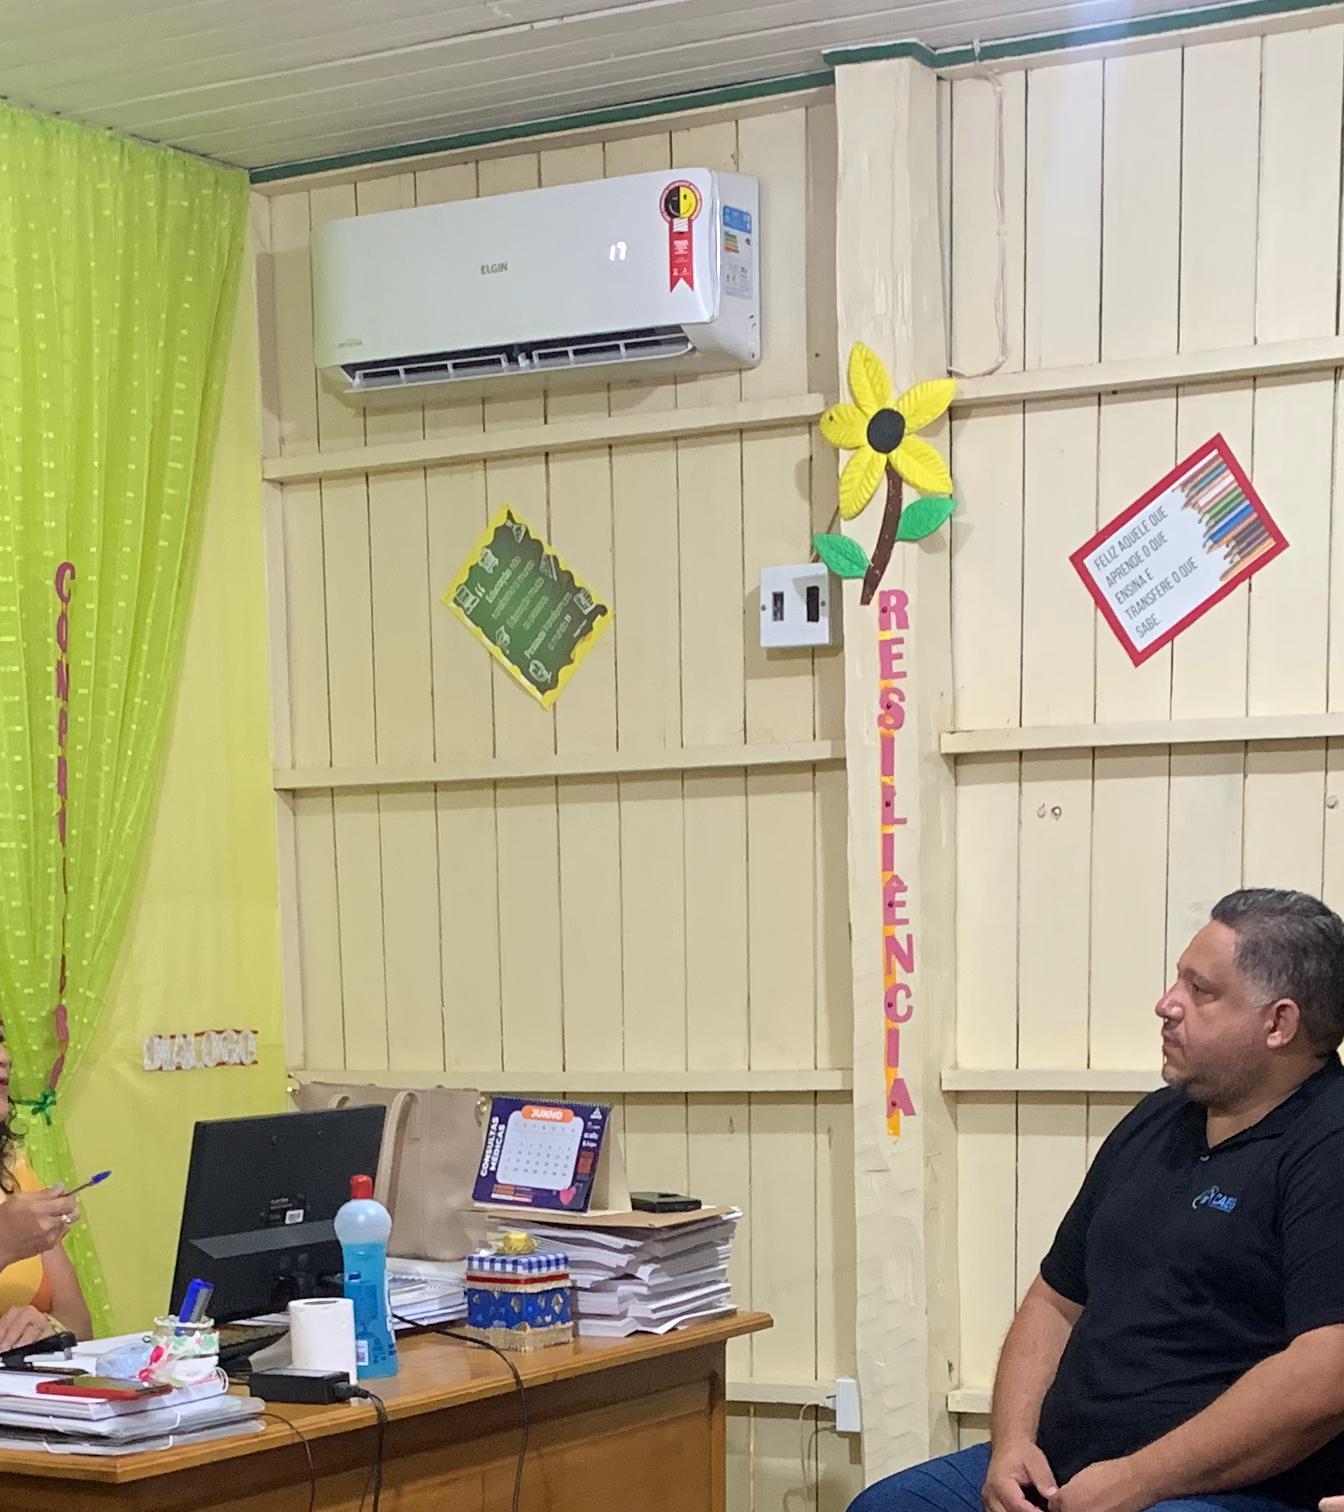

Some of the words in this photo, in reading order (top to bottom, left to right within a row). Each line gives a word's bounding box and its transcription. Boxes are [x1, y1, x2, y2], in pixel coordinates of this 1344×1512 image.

[480, 261, 508, 275] ELGIN
[1093, 547, 1120, 572] FELIZ
[1117, 519, 1152, 556] AQUELE
[1148, 505, 1168, 528] QUE
[1105, 547, 1144, 589] APRENDE
[1142, 545, 1150, 558] O
[1148, 531, 1168, 553] QUE
[1114, 573, 1147, 605] ENSINA
[1145, 567, 1153, 581] E
[1124, 574, 1175, 621] TRANSFERE
[1172, 571, 1181, 584] O
[1178, 556, 1199, 580] QUE
[480, 1116, 499, 1177] CONSULTAS
